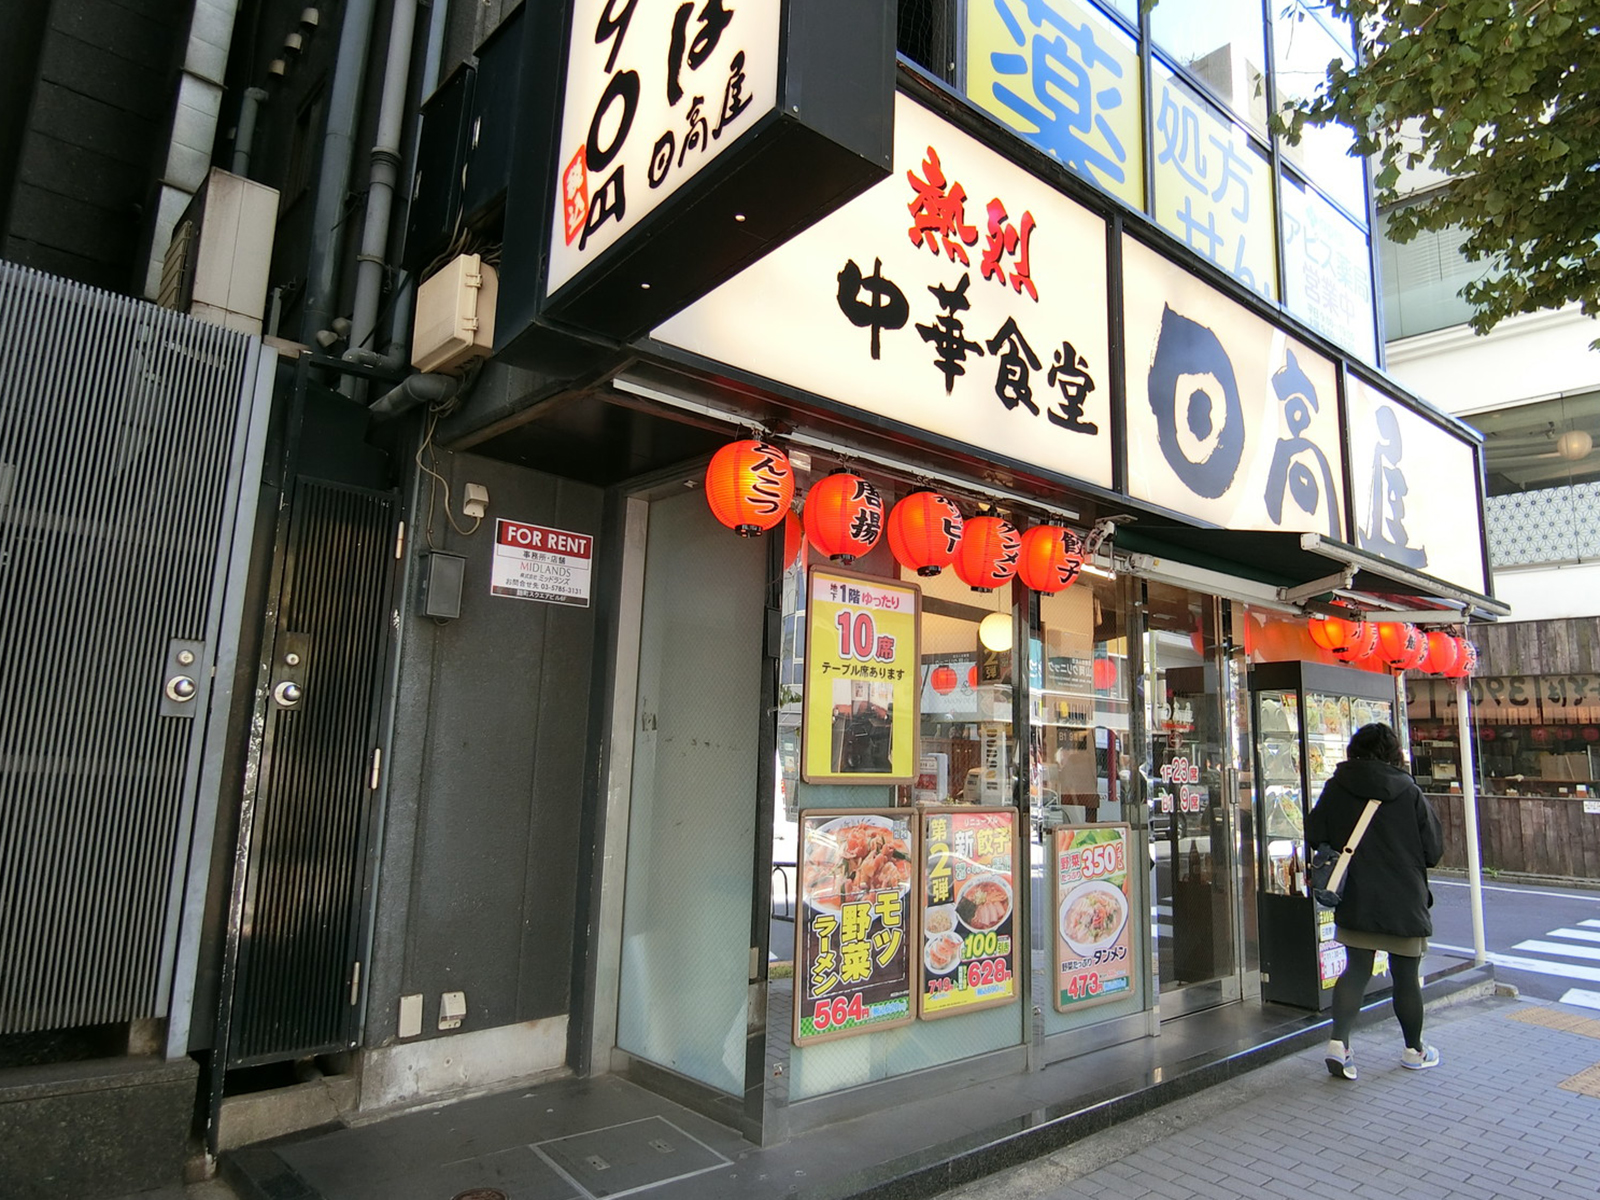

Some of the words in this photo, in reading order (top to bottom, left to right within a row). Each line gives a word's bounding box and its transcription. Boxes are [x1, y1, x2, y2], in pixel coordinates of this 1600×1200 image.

[990, 0, 1128, 186] 薬
[1156, 85, 1254, 225] 処方
[836, 256, 1099, 436] 中華食堂
[1147, 300, 1429, 570] 日高屋
[507, 525, 542, 547] FOR
[547, 533, 587, 554] RENT
[849, 479, 884, 546] 唐揚
[520, 561, 571, 578] MIDLANDS
[821, 660, 905, 682] テーブル席あります
[835, 610, 896, 662] 10席
[928, 818, 952, 903] 第2弾
[1082, 844, 1116, 878] 350
[812, 914, 839, 997] ラーメン
[840, 901, 873, 983] 野菜
[873, 891, 903, 967] モツ
